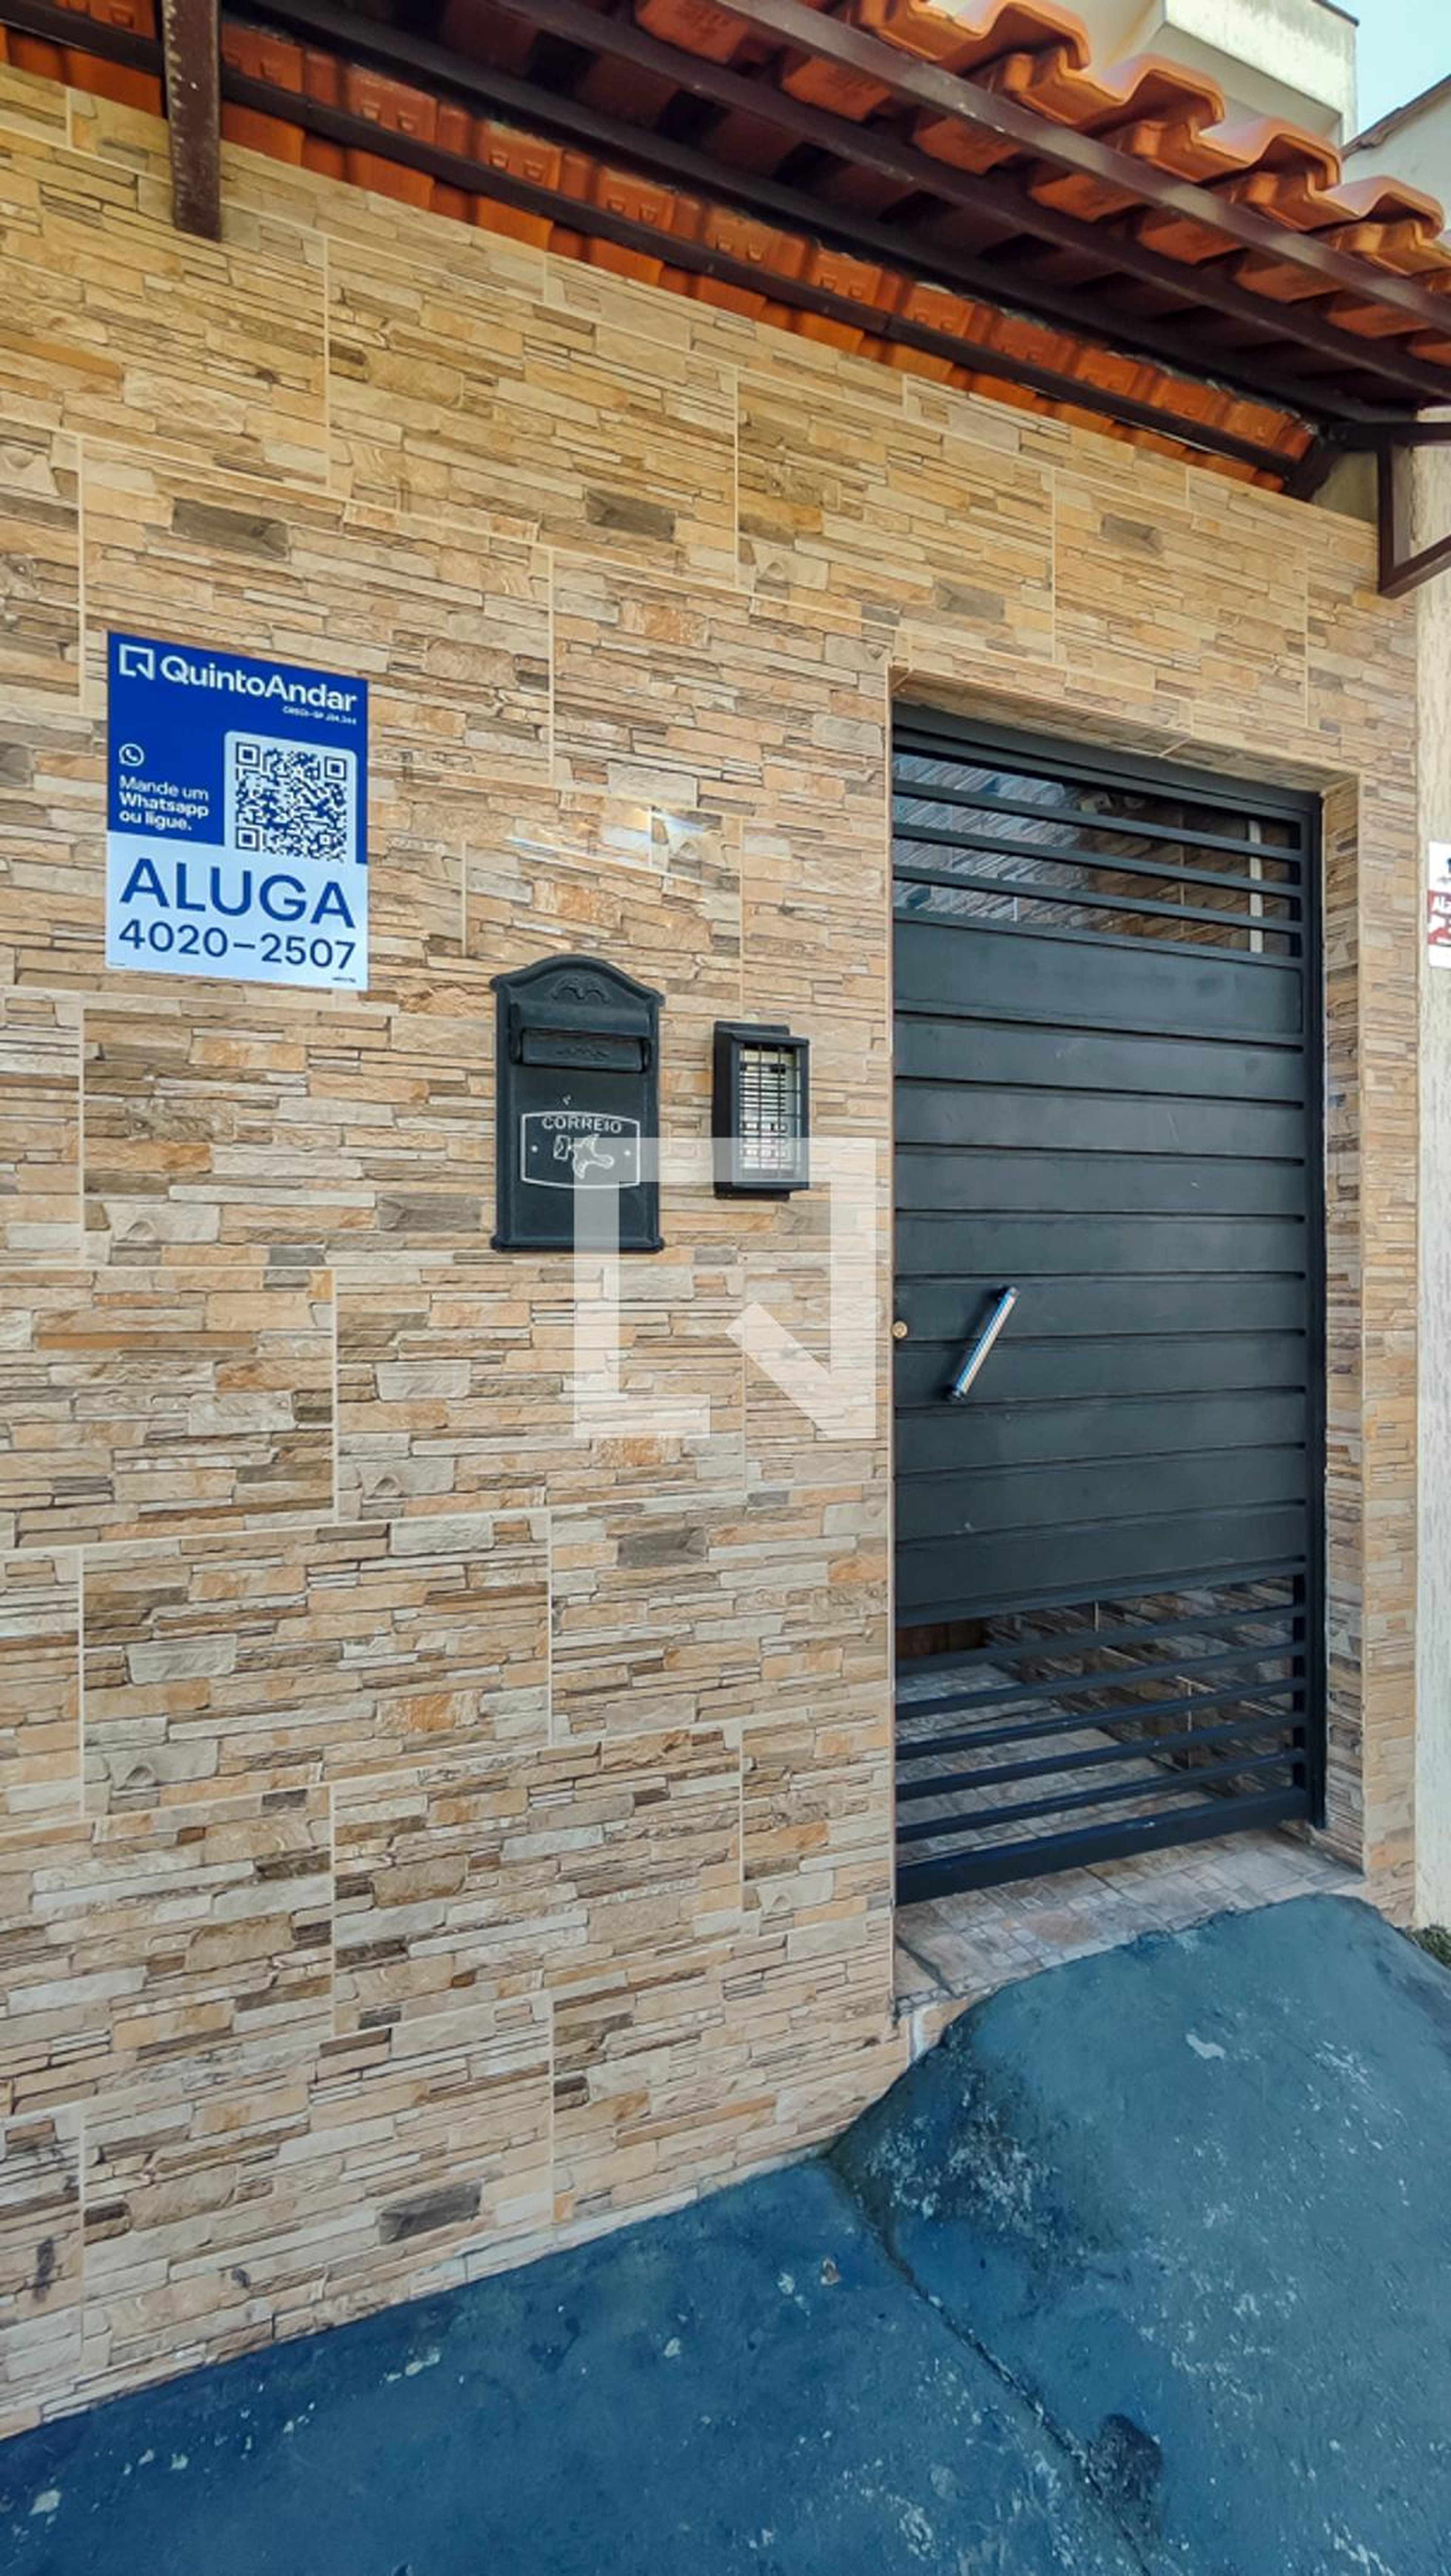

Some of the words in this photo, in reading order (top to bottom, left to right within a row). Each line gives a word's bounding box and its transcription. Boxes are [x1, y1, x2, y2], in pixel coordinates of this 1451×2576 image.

[160, 656, 357, 712] QuintoAndar
[119, 775, 179, 797] Mande
[182, 787, 209, 801] um
[119, 791, 209, 819] Whatsapp
[119, 810, 142, 824] ou
[145, 810, 192, 831] ligue.
[120, 858, 355, 928] ALUGA
[119, 919, 356, 969] 4020-2507
[542, 1115, 622, 1133] CORREIO
